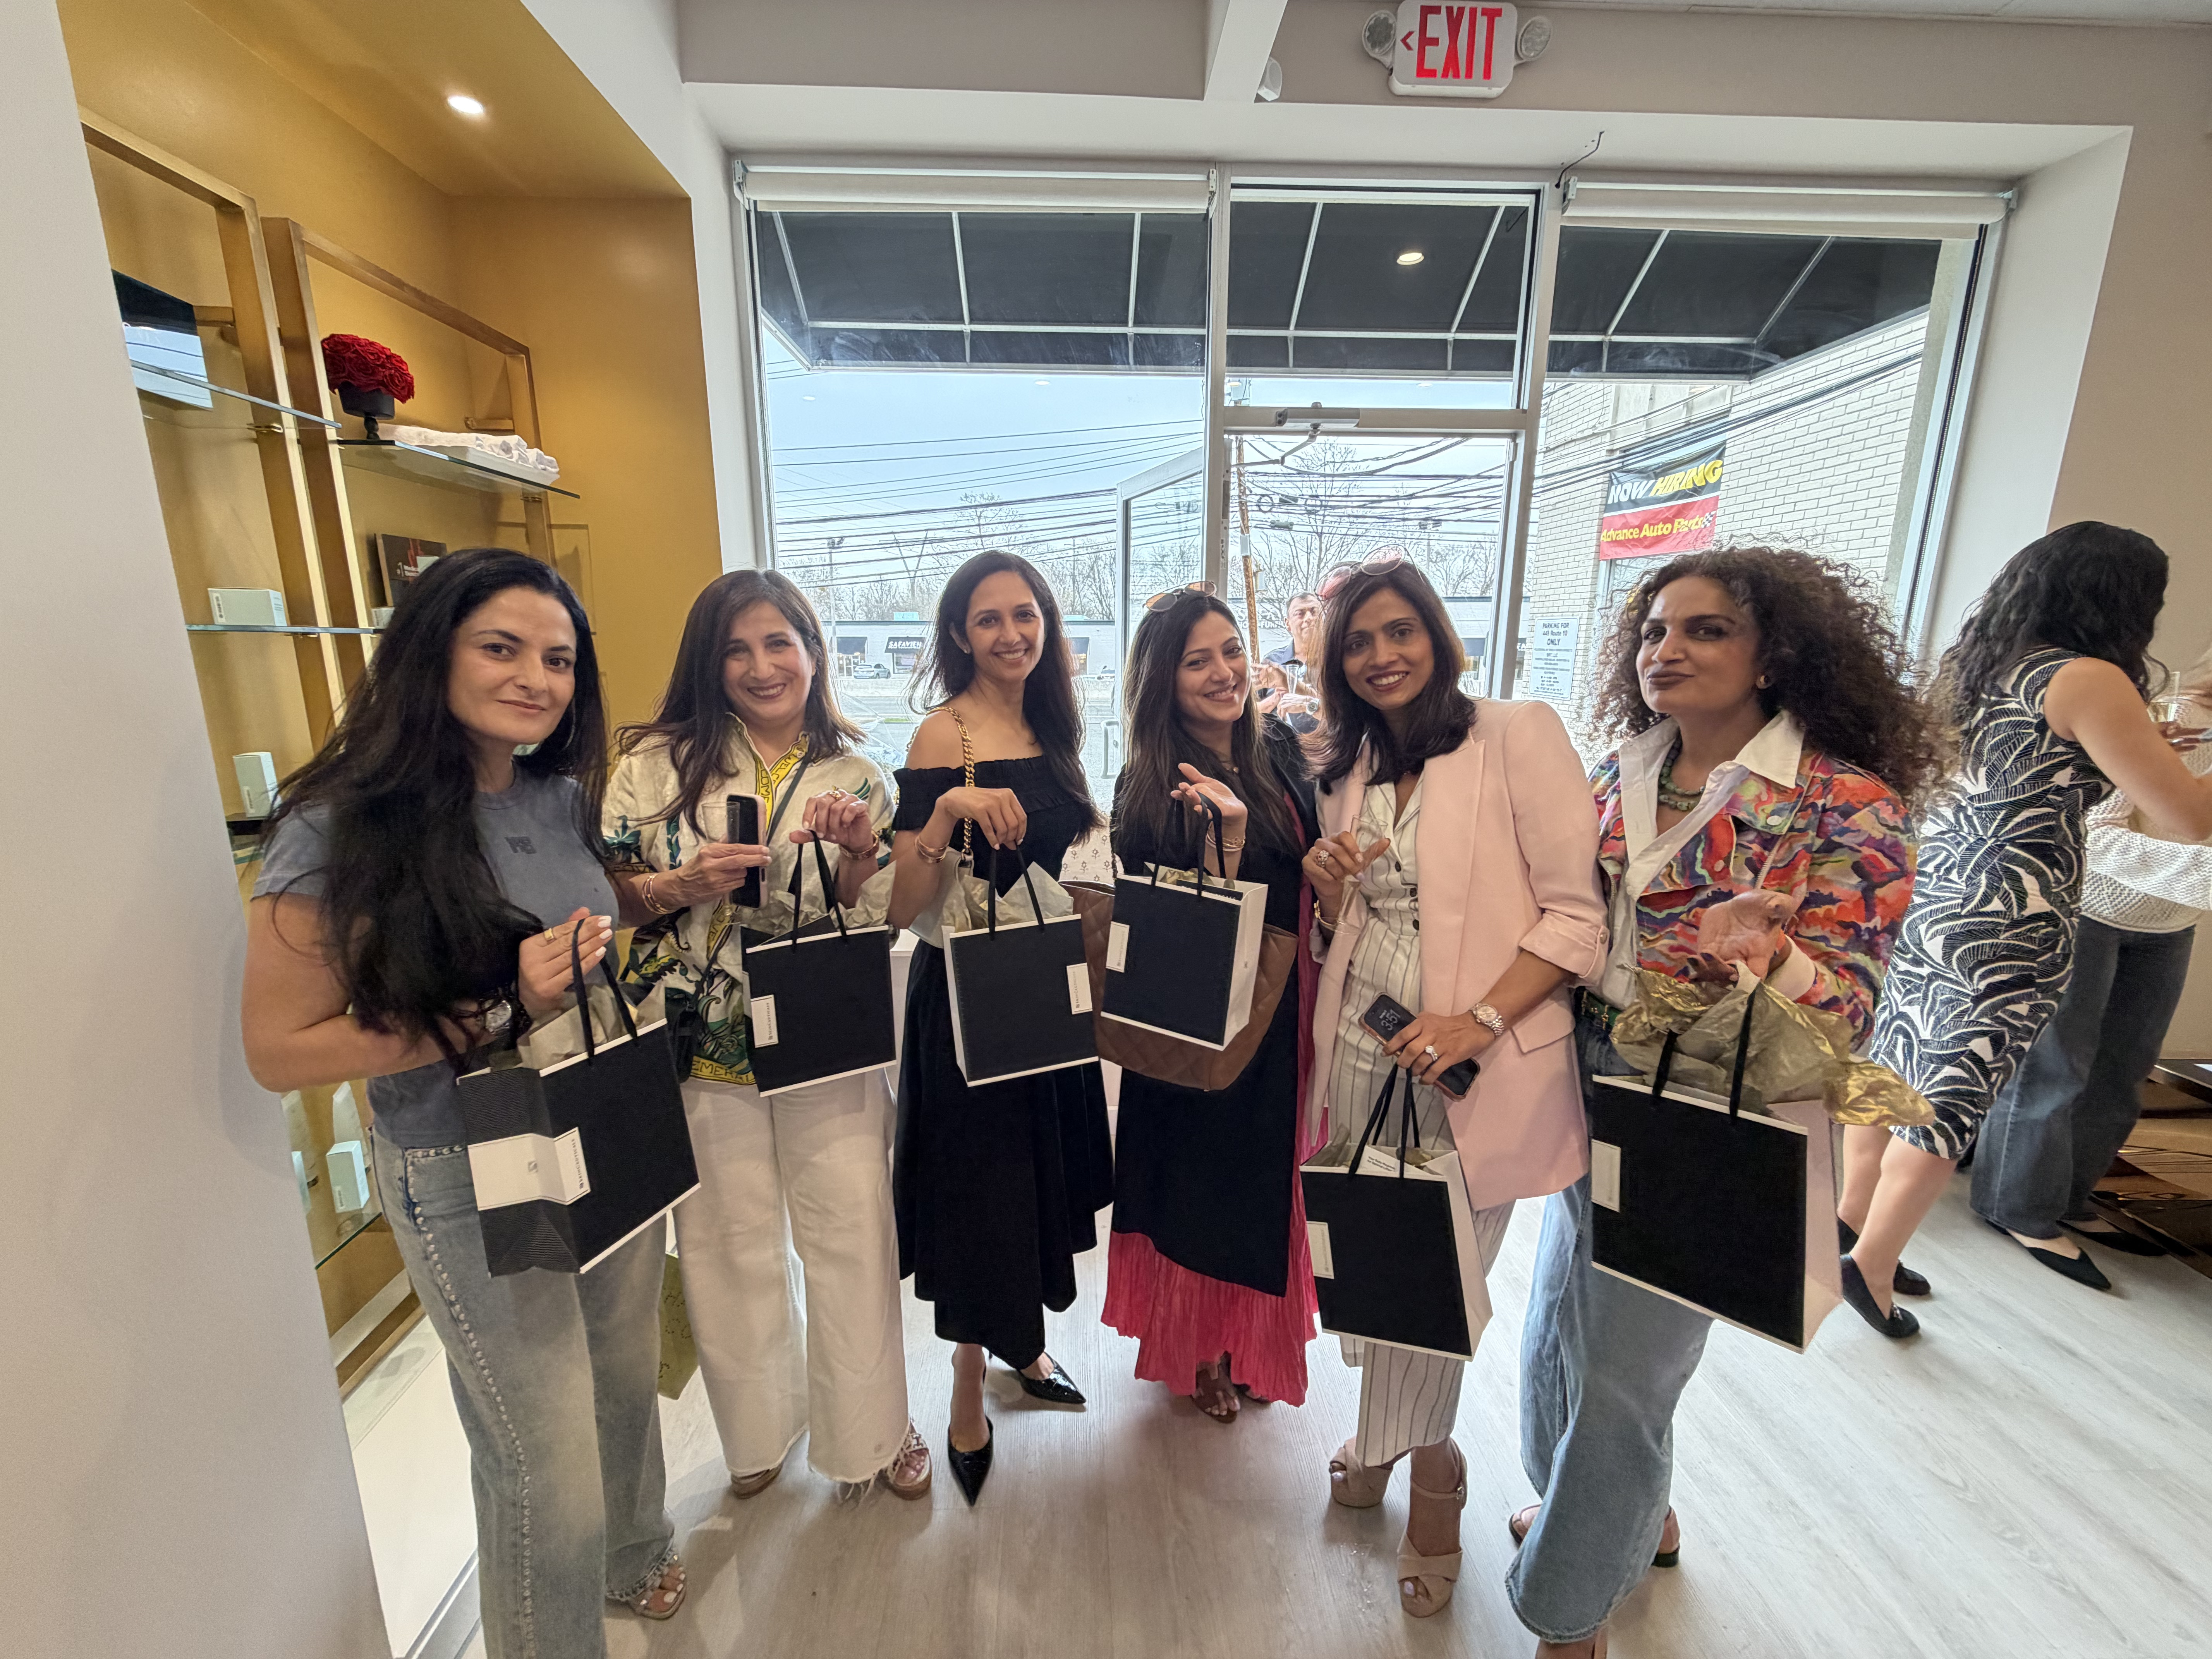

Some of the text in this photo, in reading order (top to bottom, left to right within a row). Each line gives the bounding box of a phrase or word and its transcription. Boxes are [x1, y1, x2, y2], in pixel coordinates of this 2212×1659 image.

[1416, 5, 1502, 80] EXIT
[1607, 460, 1723, 504] NOW HIRING
[1601, 515, 1704, 542] Advance Auto Parts
[1381, 1009, 1401, 1030] 3:51
